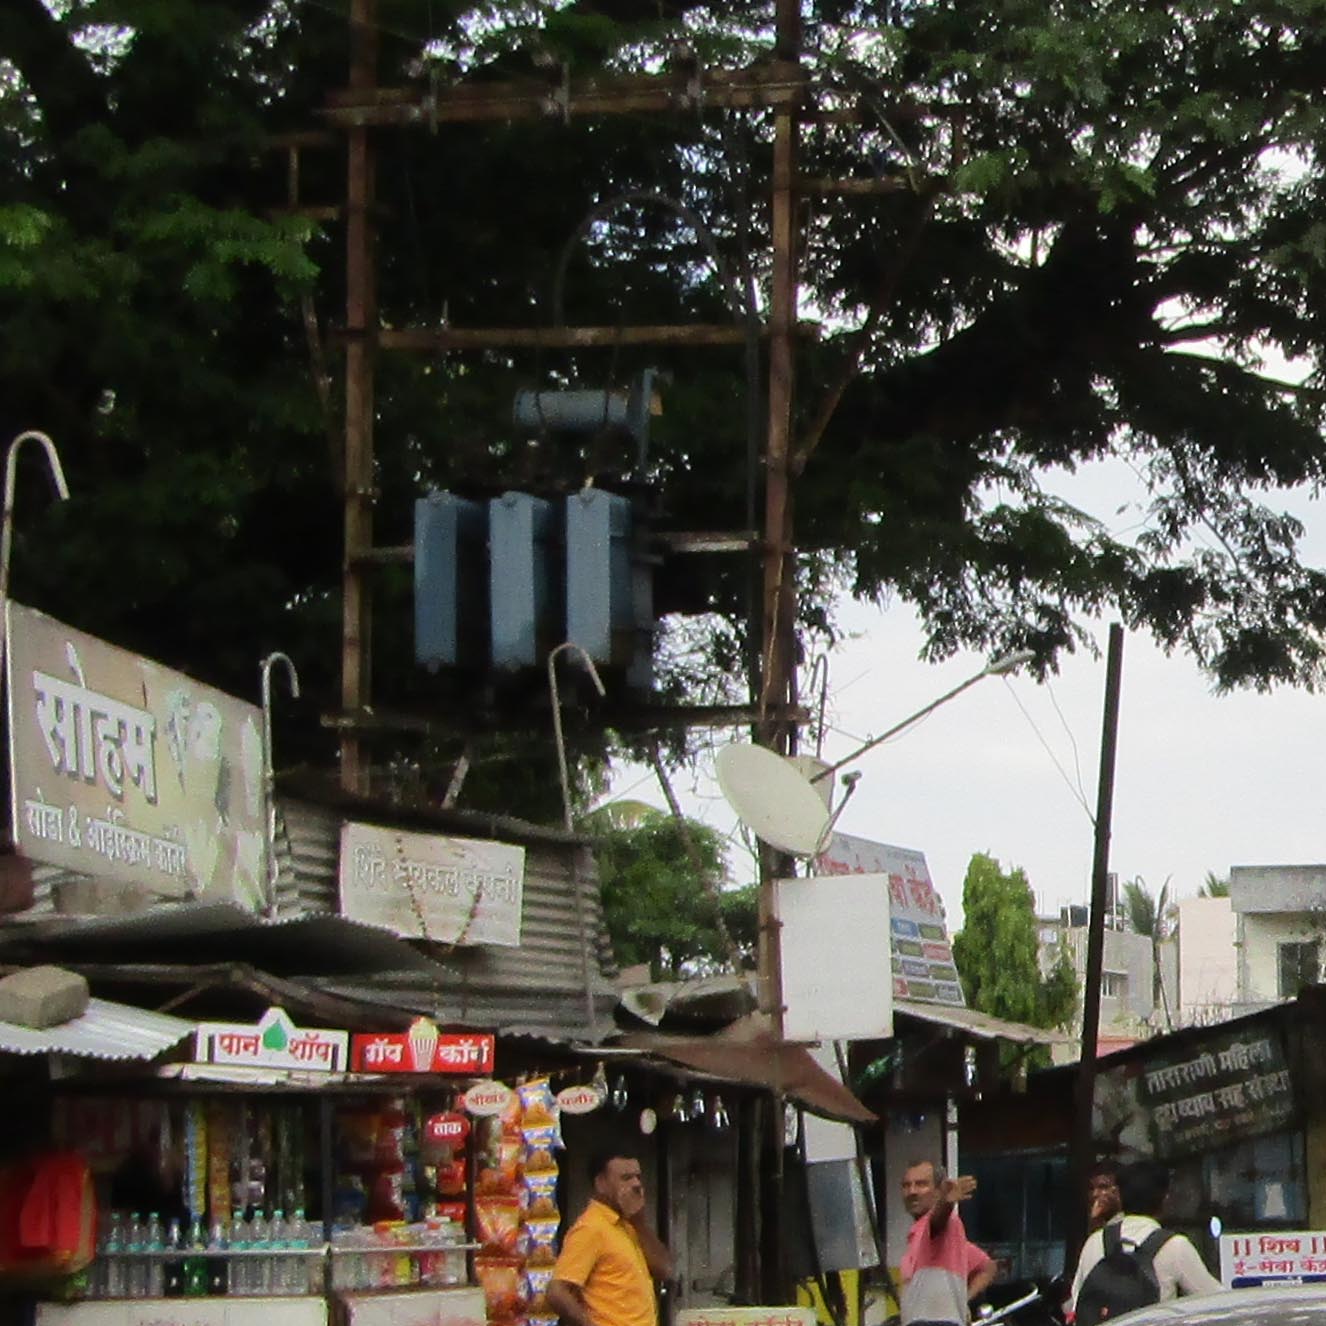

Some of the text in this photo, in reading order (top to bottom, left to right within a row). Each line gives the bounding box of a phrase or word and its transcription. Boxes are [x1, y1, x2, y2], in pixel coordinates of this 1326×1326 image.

[33, 641, 158, 806] सोहम
[69, 804, 81, 848] &
[220, 1031, 333, 1062] पान शॉप
[433, 1118, 462, 1136] ताक
[1260, 1236, 1300, 1254] शिव
